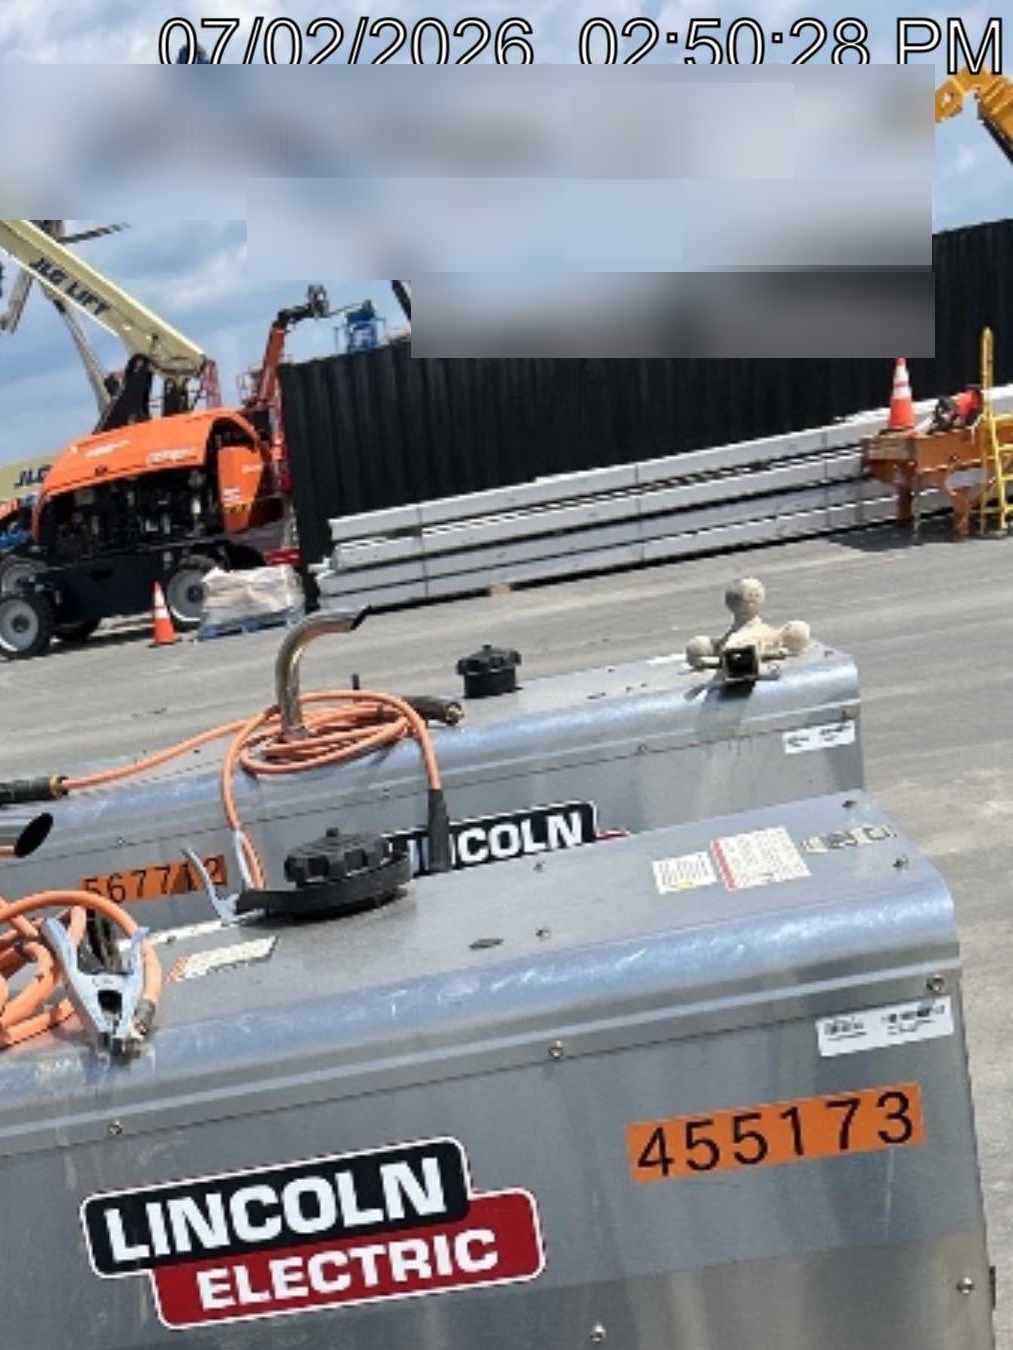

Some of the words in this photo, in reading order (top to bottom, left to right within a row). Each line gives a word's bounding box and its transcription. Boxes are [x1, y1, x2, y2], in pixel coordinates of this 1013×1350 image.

[637, 1090, 914, 1177] 455173
[103, 1155, 449, 1263] LINCOLN
[195, 1228, 499, 1311] ELECTRIC
